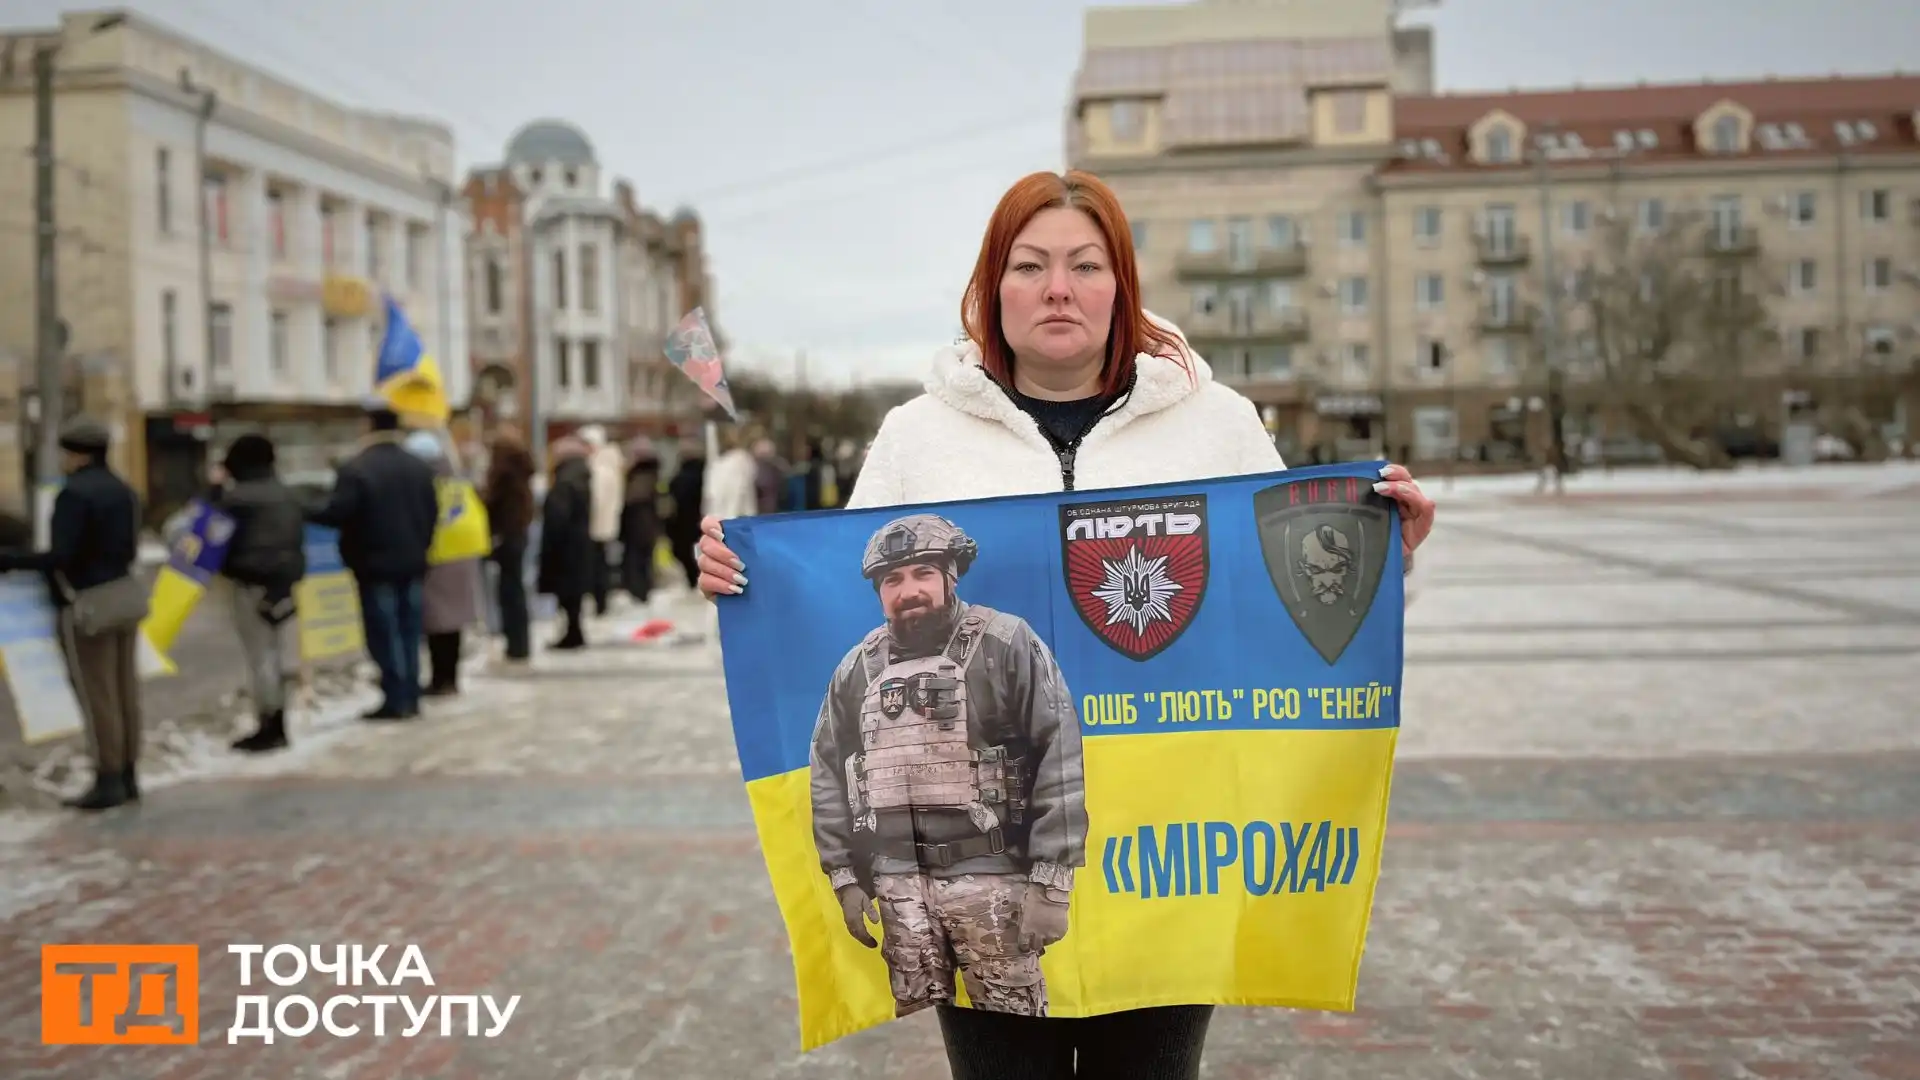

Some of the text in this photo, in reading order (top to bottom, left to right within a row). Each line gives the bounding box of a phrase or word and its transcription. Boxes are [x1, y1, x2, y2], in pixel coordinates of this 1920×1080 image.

[1066, 507, 1112, 517] ОБЄДНАНА
[1066, 513, 1201, 540] ЛЮТЬ
[1083, 682, 1392, 725] ОШБ "ЛЮТЬ" РСО "ЕНЕЙ"
[1102, 820, 1359, 899] «МІРОХА»
